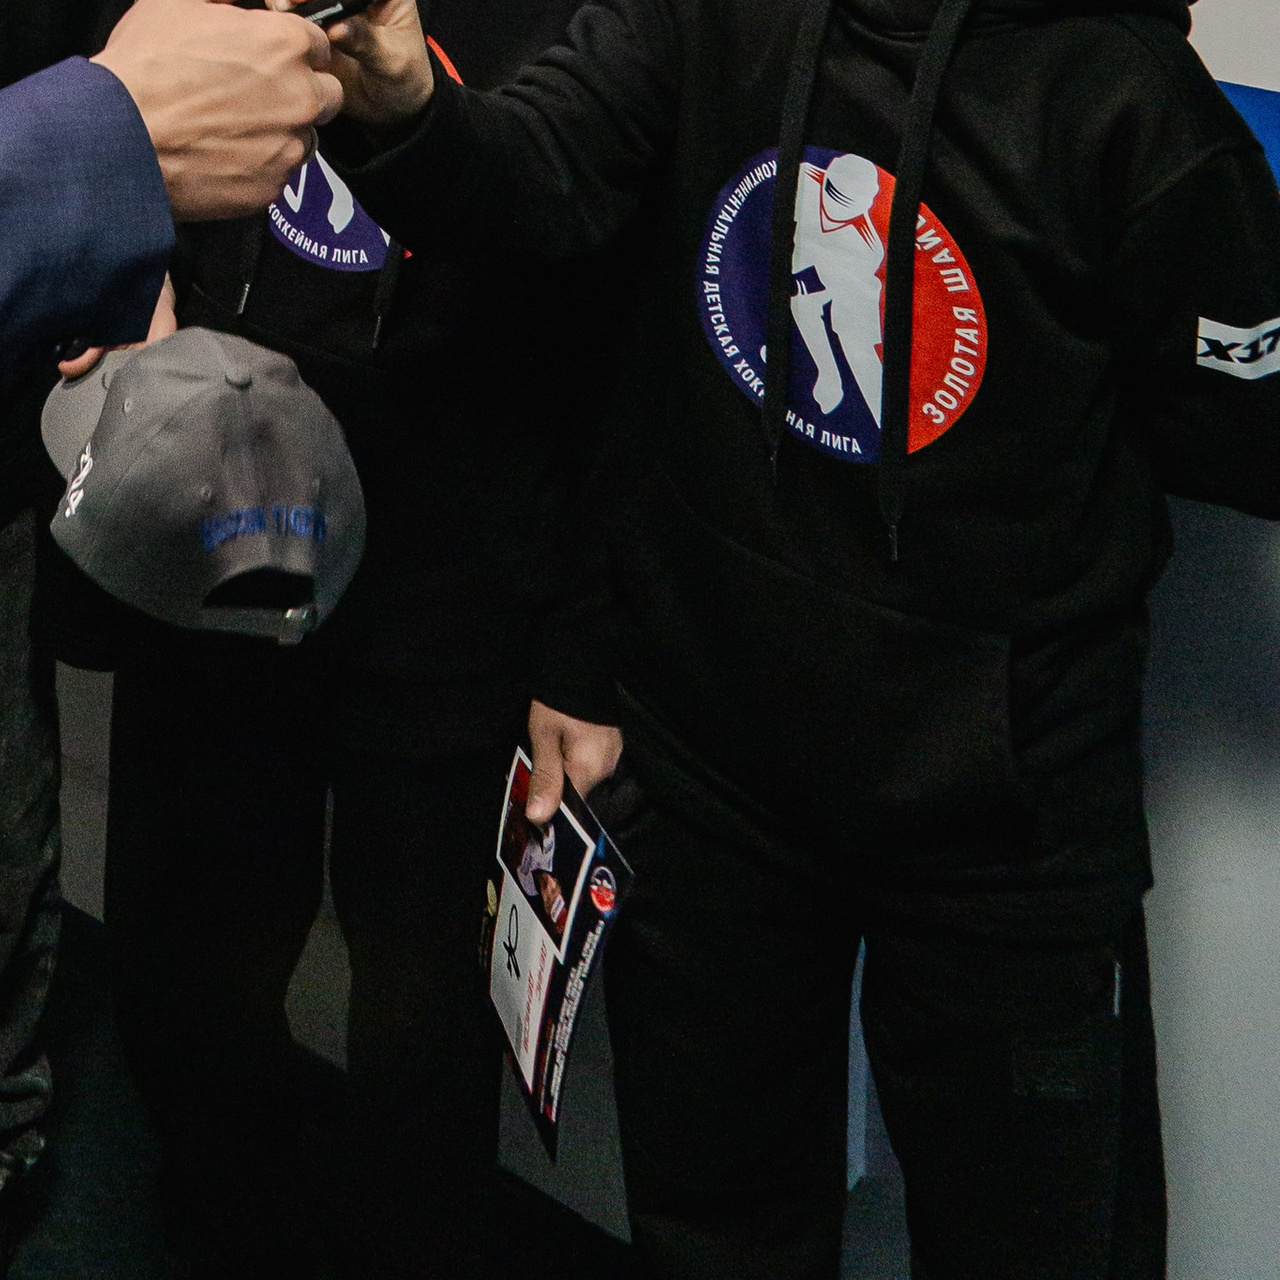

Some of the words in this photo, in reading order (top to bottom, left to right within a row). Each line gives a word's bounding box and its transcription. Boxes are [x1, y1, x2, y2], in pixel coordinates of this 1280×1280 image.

[268, 202, 328, 260] ХОККЕЙНАЯ
[332, 246, 369, 264] ЛИГА
[705, 160, 778, 275] КОНТИНЕНТАЛЬНАЯ
[915, 213, 970, 292] ШАЙ
[702, 280, 740, 358] ДЕТСКАЯ
[922, 306, 980, 425] ЗОЛОТАЯ
[820, 430, 862, 454] ЛИГА
